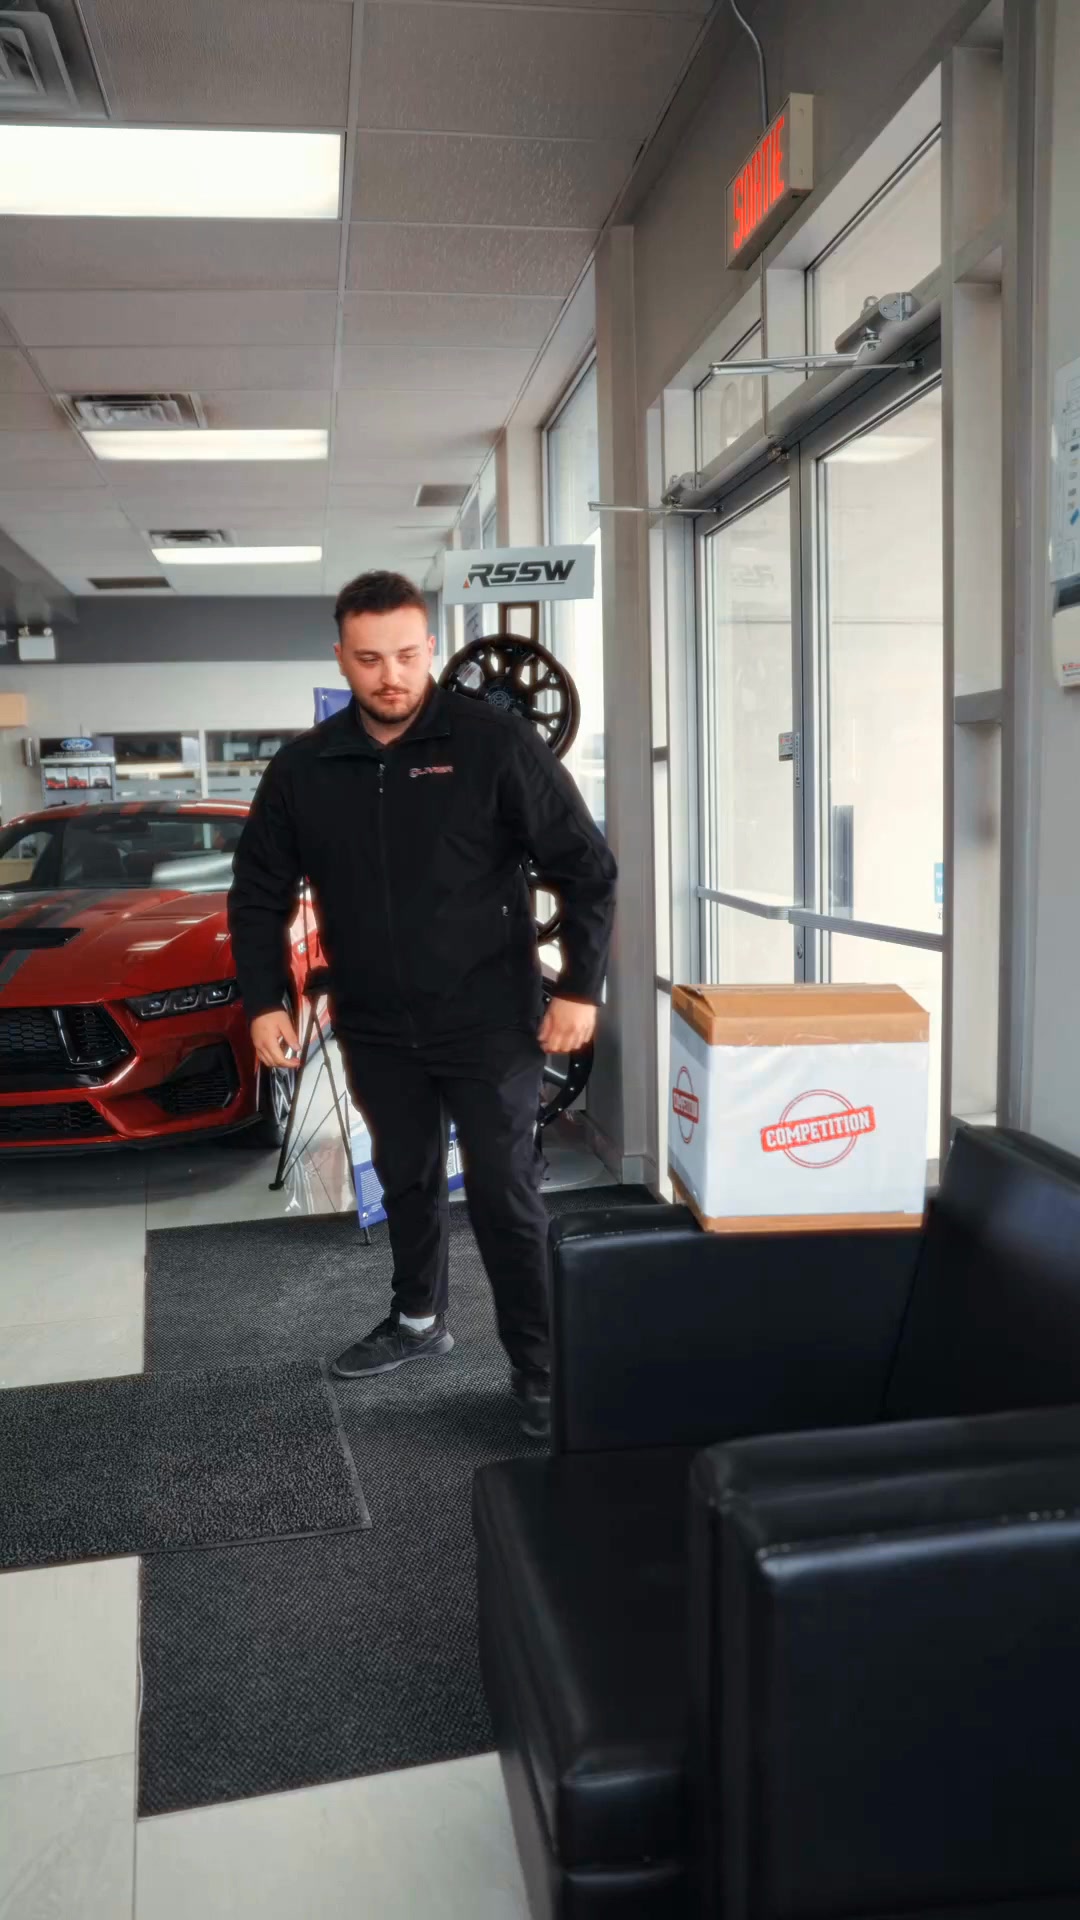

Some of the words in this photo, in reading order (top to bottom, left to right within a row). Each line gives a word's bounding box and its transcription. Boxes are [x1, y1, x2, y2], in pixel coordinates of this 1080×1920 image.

[733, 114, 785, 250] SORTIE
[467, 558, 577, 587] RSSW
[765, 1110, 872, 1148] COMPETITION
